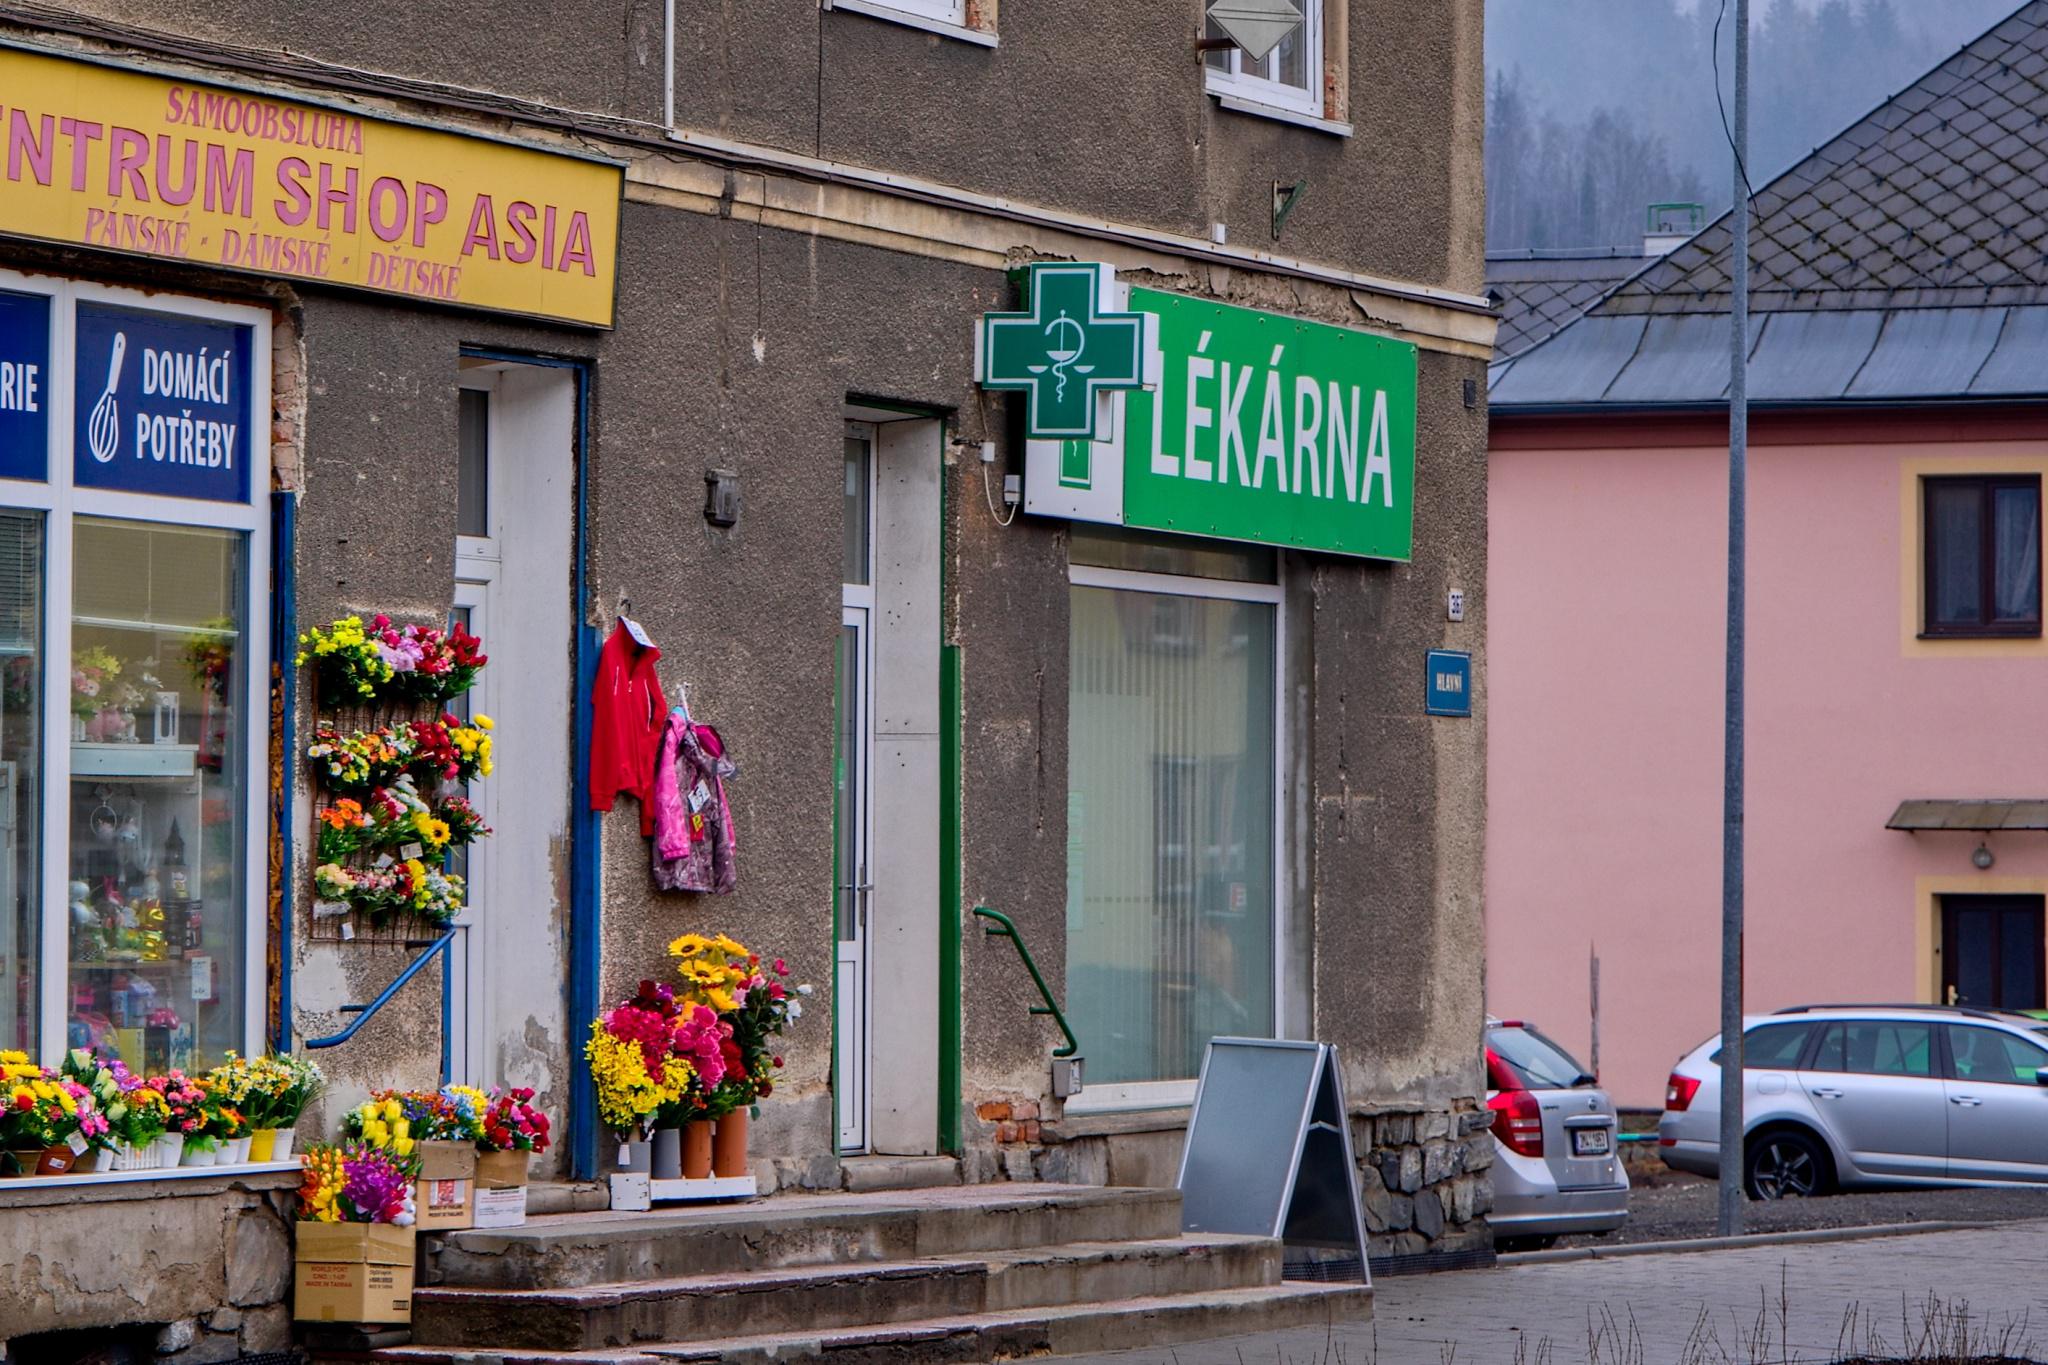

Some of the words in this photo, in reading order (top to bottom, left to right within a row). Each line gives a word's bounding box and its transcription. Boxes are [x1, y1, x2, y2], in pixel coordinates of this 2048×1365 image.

[165, 86, 363, 155] SAMOOBSLUHA
[0, 105, 255, 218] NTRUM
[274, 156, 448, 249] SHOP
[461, 193, 596, 277] ASIA
[84, 200, 191, 258] PÁNSKÉ
[220, 222, 331, 277] DÁMSKÉ
[367, 245, 463, 300] DĚTSKÉ
[144, 347, 231, 405] DOMÁCÍ
[136, 408, 237, 470] POTŘEBY
[1151, 330, 1393, 508] LÉKÁRNA
